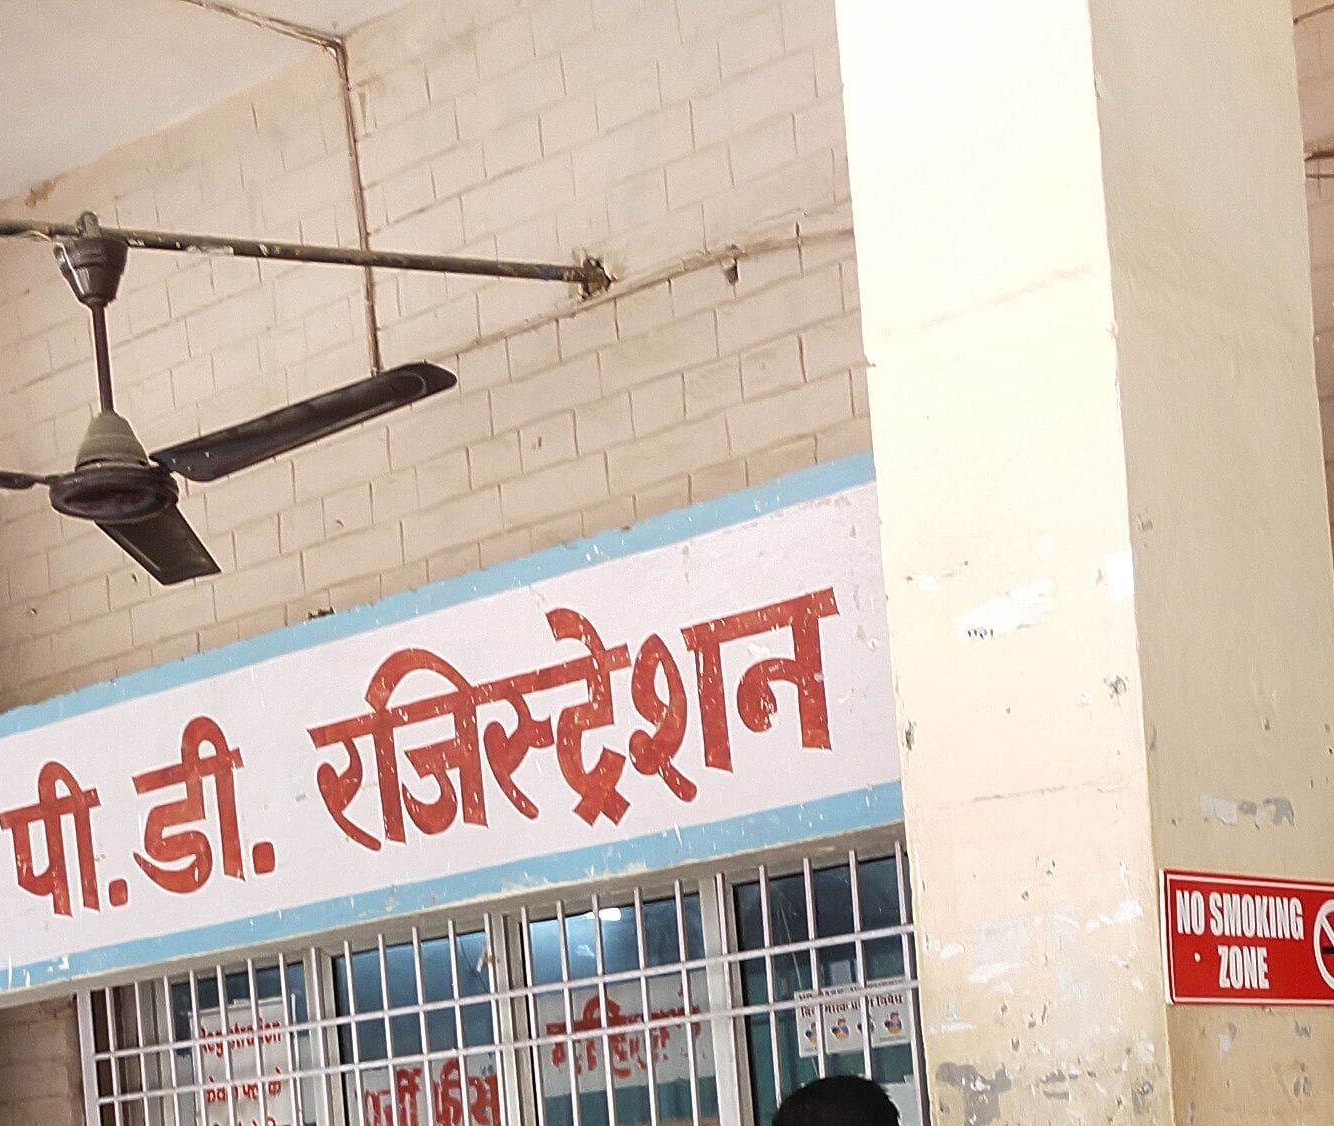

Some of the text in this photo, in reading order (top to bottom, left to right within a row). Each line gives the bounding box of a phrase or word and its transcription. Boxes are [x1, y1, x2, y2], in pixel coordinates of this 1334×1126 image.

[132, 715, 276, 894] डी.
[307, 587, 841, 851] रजिस्ट्रेशन
[1176, 889, 1306, 941] NO SMOKING
[1217, 943, 1271, 991] ZONE
